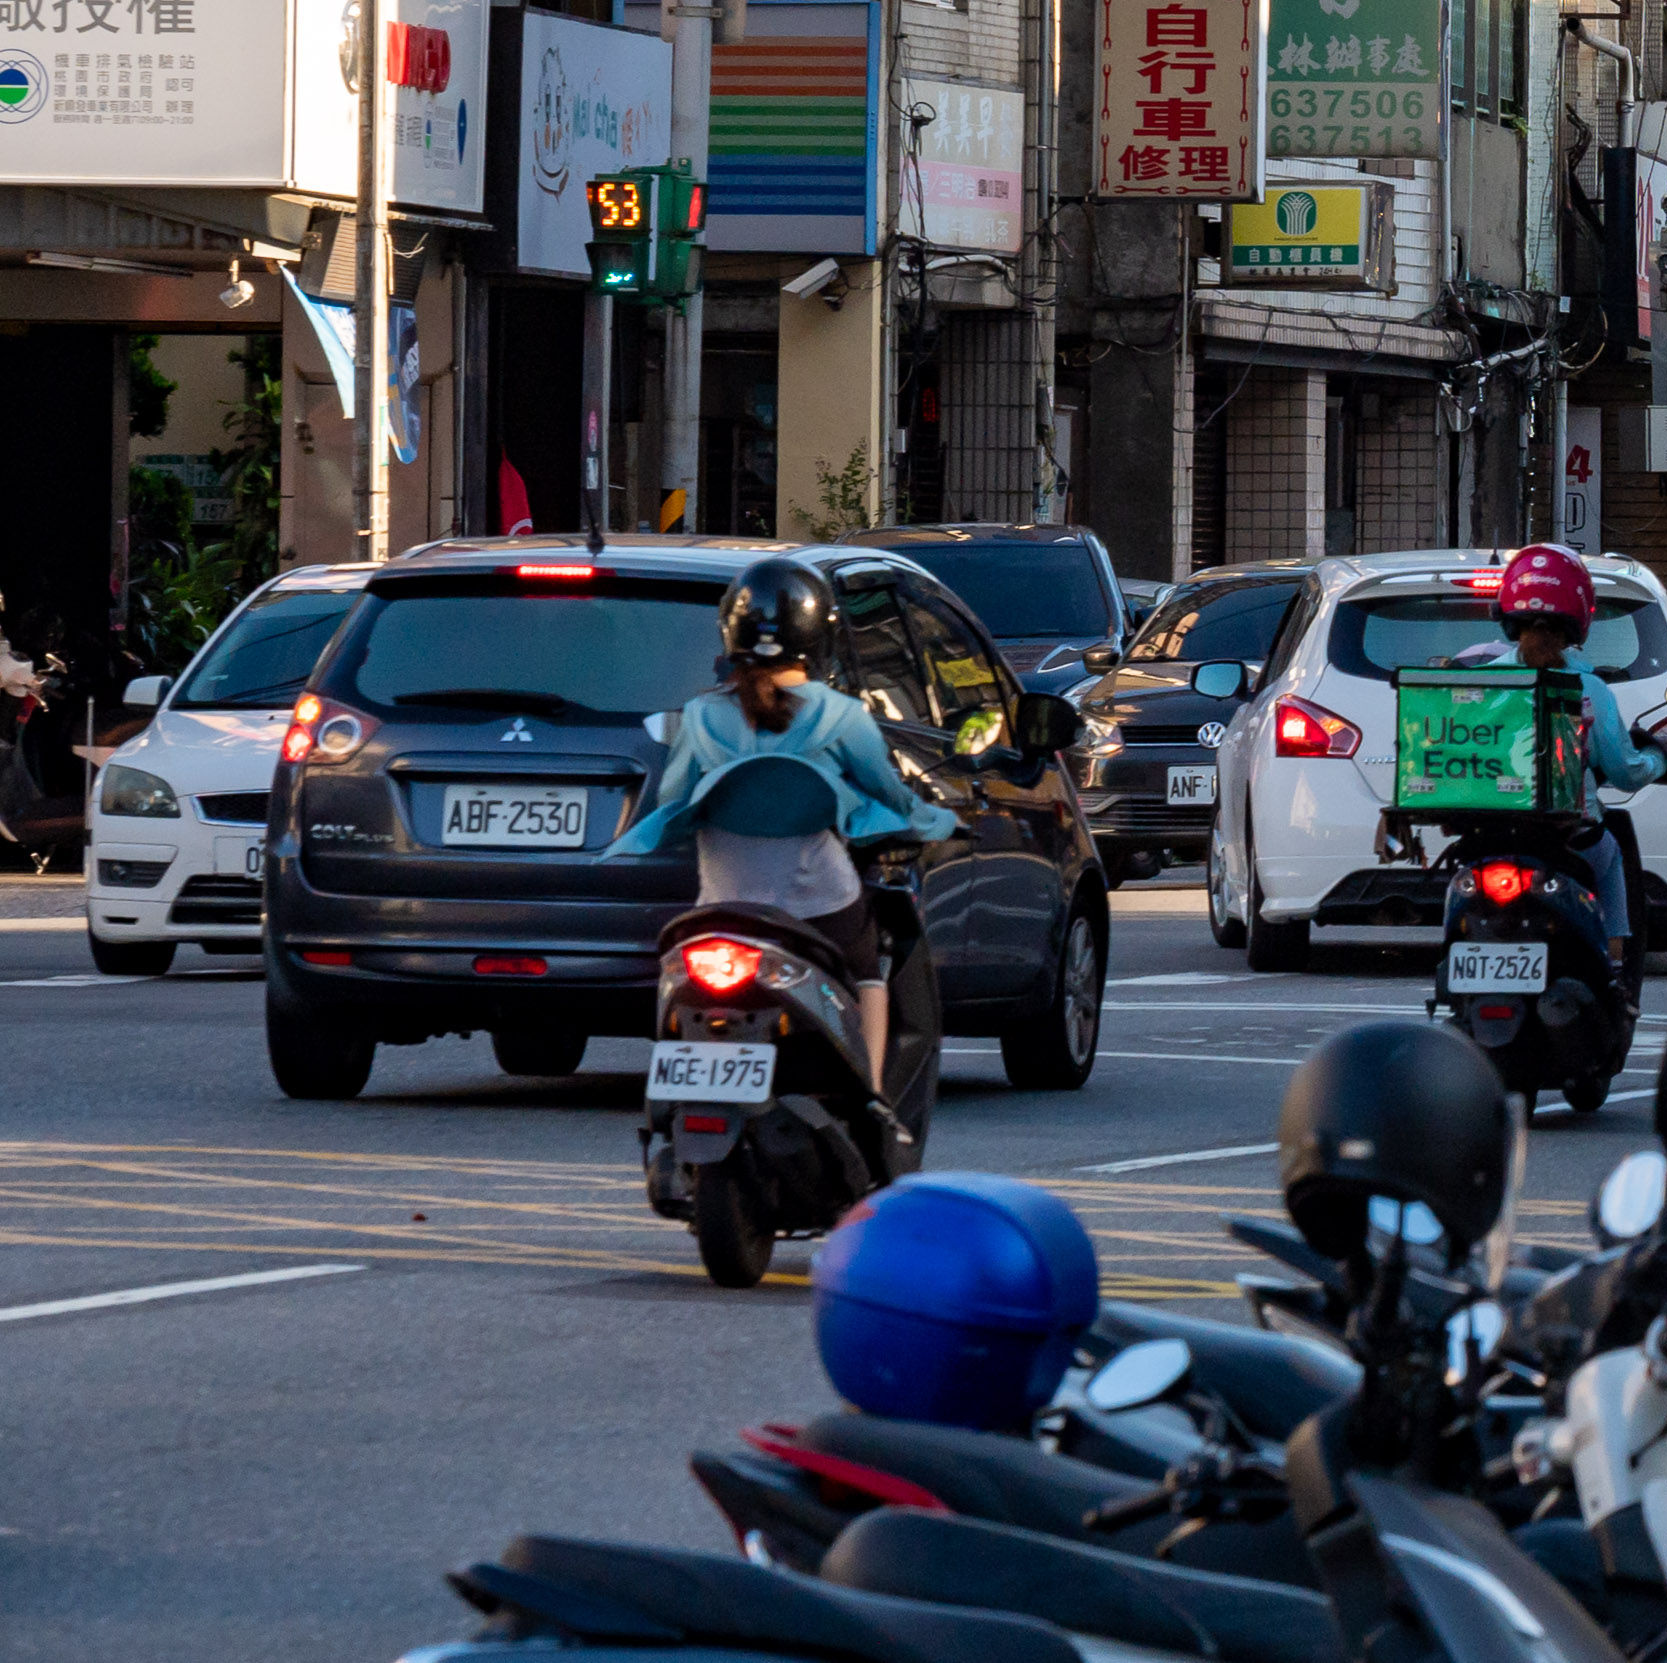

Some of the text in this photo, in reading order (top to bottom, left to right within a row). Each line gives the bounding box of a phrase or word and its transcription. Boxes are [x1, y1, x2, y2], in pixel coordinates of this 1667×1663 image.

[1135, 3, 1218, 142] 自行車
[1267, 33, 1430, 77] 林辦事處
[1270, 88, 1424, 120] 637506
[1117, 143, 1232, 183] 修理
[598, 182, 641, 227] 53
[1248, 246, 1344, 264] 自動櫃員機
[1423, 715, 1505, 746] Uber
[1423, 750, 1503, 780] Eats
[1169, 772, 1216, 800] ANF-
[310, 822, 356, 840] COLT
[446, 799, 582, 835] ABF-2530
[1452, 951, 1545, 987] NQT-2526
[653, 1051, 768, 1093] NGE-1975
